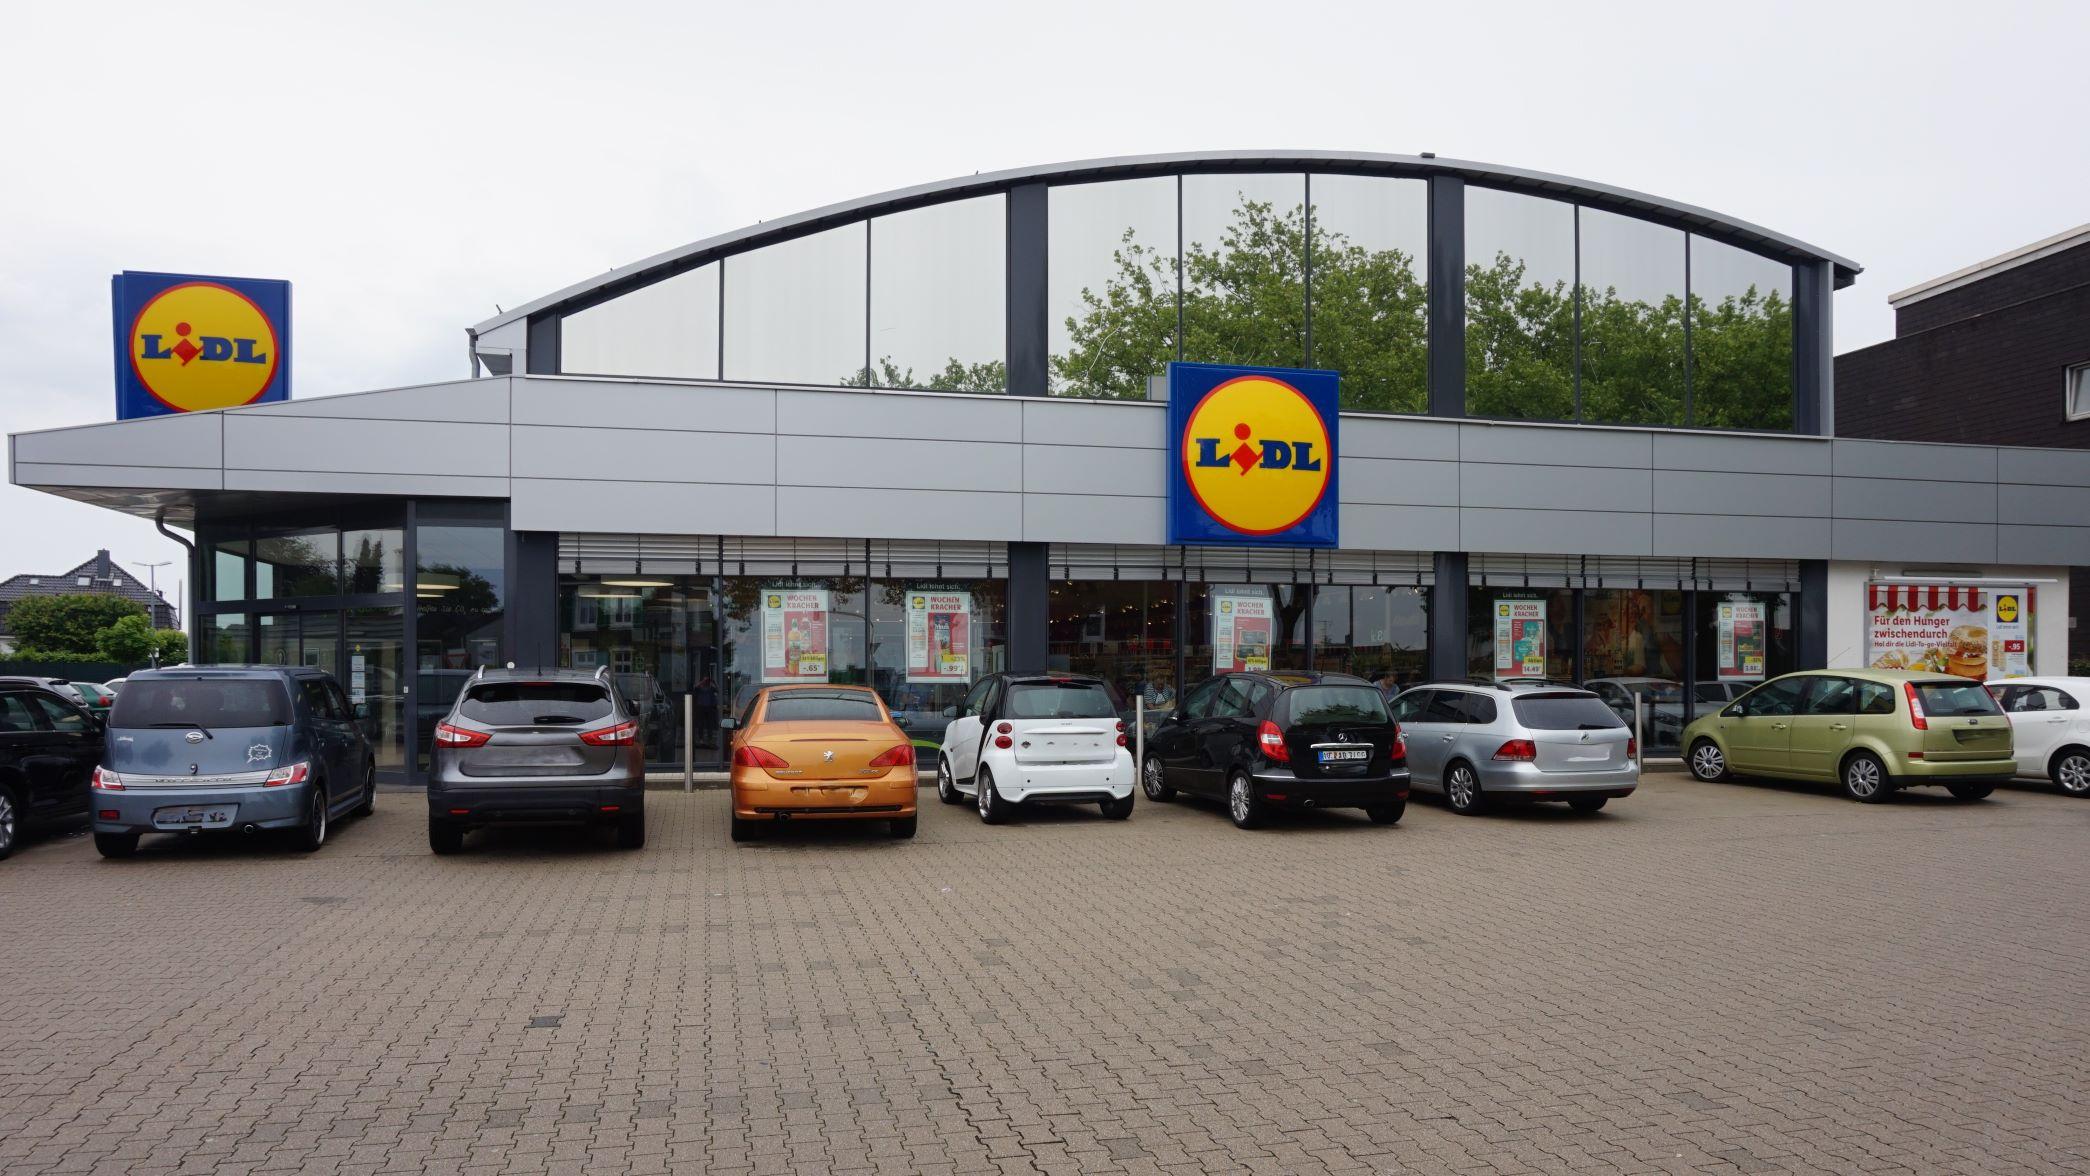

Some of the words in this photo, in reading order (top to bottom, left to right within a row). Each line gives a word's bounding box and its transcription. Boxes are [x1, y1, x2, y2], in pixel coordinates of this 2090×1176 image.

[786, 594, 817, 602] WOCHEN
[1874, 615, 1890, 626] Für
[1892, 615, 1911, 626] den
[1913, 615, 1950, 629] Hunger
[1874, 628, 1948, 639] zwischendurch
[1874, 640, 1885, 648] Hol
[1885, 640, 1894, 648] dir
[1895, 640, 1905, 648] die
